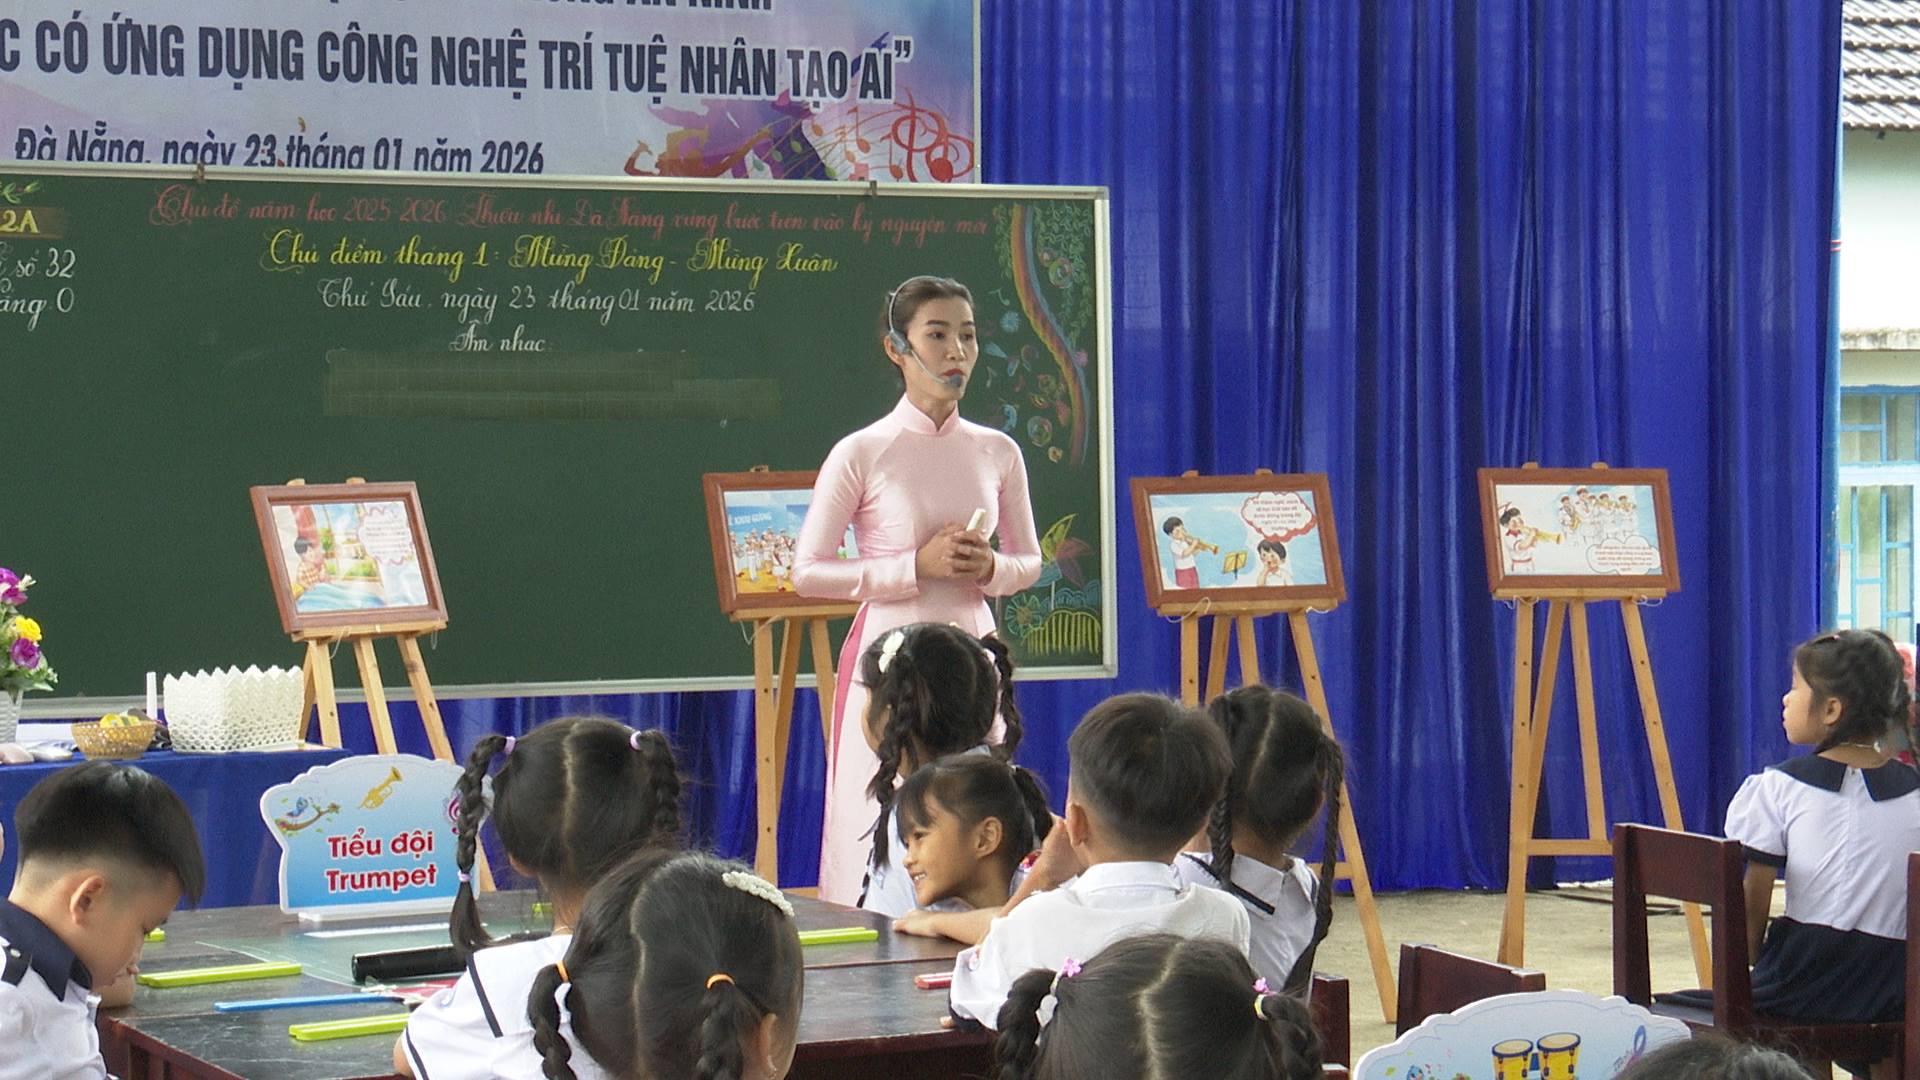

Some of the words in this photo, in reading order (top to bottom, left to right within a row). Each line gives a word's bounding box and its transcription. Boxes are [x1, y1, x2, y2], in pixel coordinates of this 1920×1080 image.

[36, 10, 89, 75] CÓ
[103, 12, 185, 77] ỨNG
[200, 26, 304, 90] DỤNG
[317, 22, 418, 85] CÔNG
[431, 28, 527, 99] NGHỆ
[539, 31, 593, 90] TRÍ
[604, 34, 668, 104] TUỆ
[680, 37, 776, 96] NHÂN
[787, 49, 848, 109] TẠO
[15, 124, 57, 160] Đà
[162, 129, 237, 166] ngày
[244, 133, 277, 167] 23
[286, 131, 365, 169] tháng
[373, 137, 402, 169] 01
[414, 138, 472, 172] năm
[480, 140, 544, 174] 2026
[45, 247, 76, 278] 32
[330, 235, 387, 265] điểm
[394, 234, 465, 283] tháng
[508, 234, 594, 285] Mừng
[686, 236, 769, 289] Mừng
[775, 241, 839, 272] Xuân
[57, 287, 74, 313] 0
[441, 287, 498, 324] ngày
[508, 285, 537, 310] 23
[547, 280, 616, 326] tháng
[618, 288, 641, 311] 01
[649, 290, 696, 313] năm
[704, 289, 756, 312] 2026
[328, 827, 382, 859] Tiểu
[390, 830, 434, 859] đội
[326, 863, 438, 892] Trumpet
